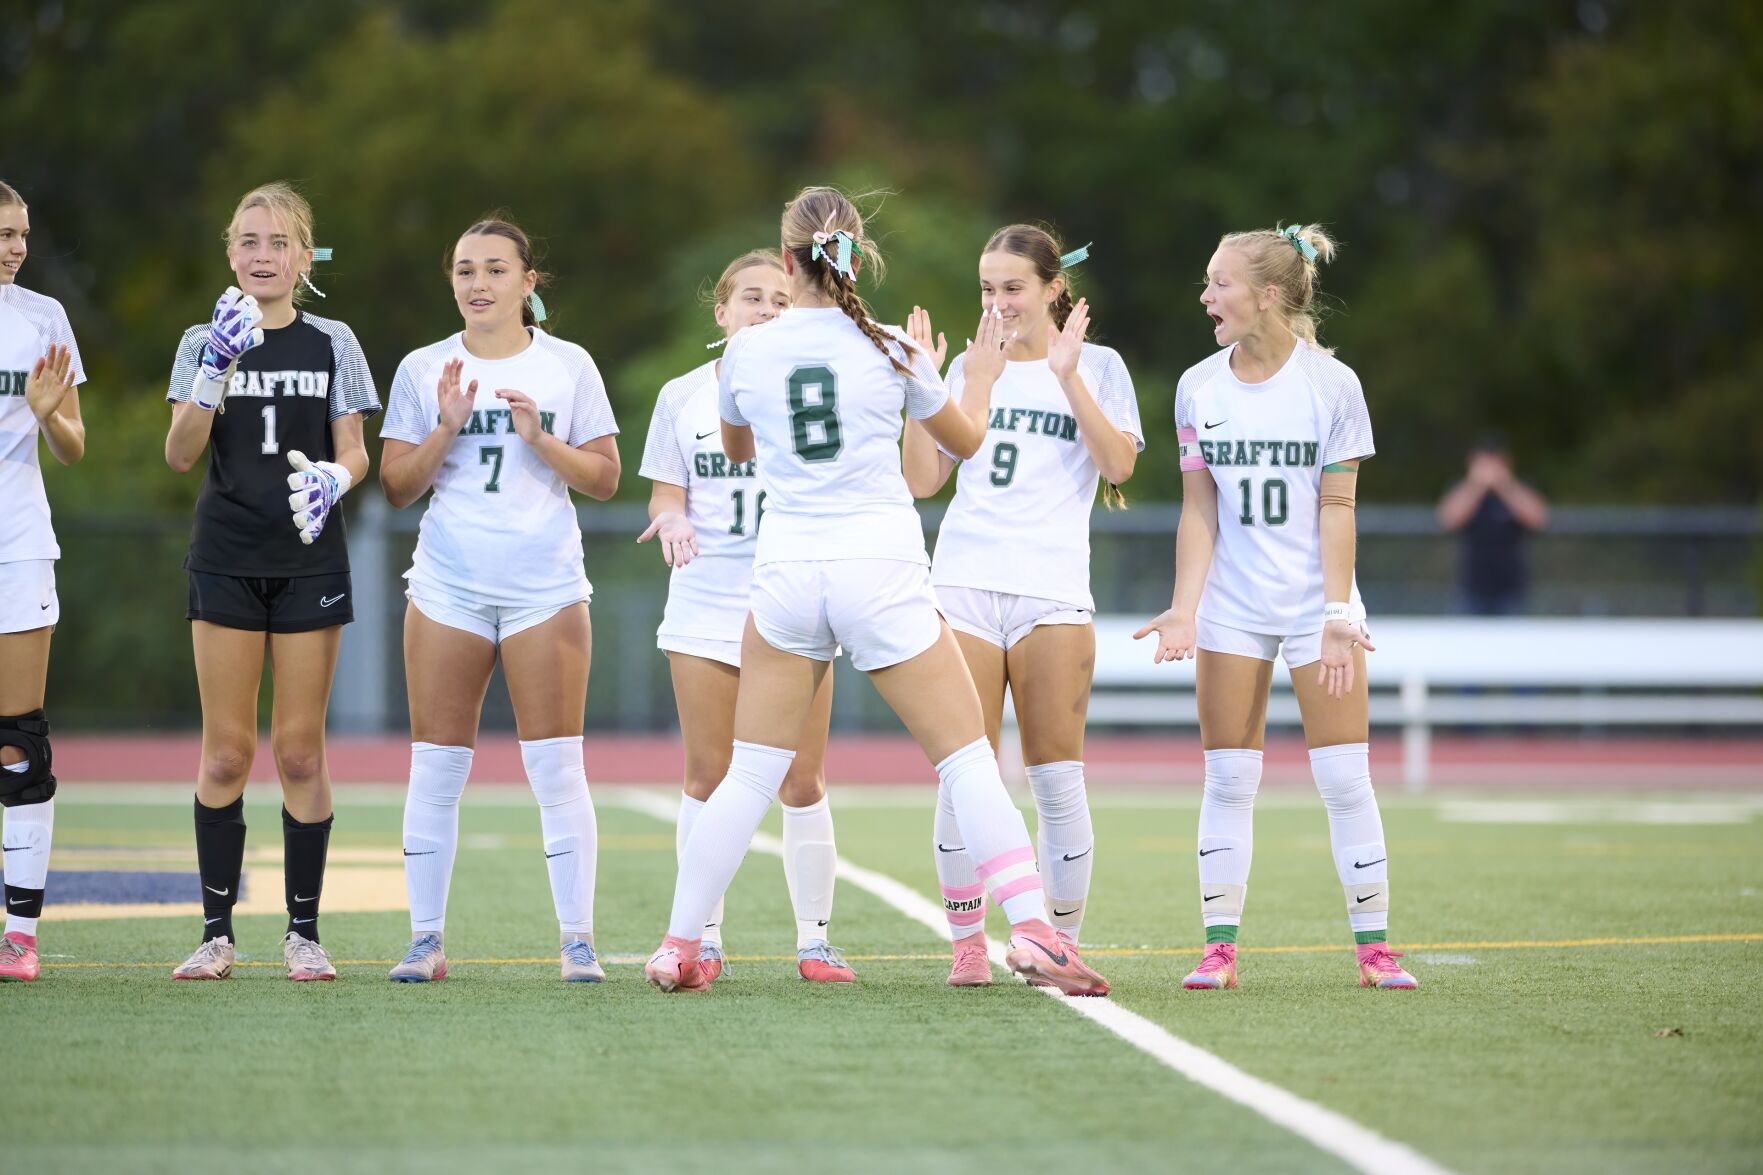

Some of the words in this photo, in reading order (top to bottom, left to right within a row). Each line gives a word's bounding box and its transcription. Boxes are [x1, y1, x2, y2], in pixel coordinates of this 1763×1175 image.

[229, 370, 329, 398] RAFTON
[262, 405, 279, 454] 1
[785, 363, 843, 464] 8
[987, 407, 1078, 443] AFTON
[479, 445, 504, 493] 7
[989, 441, 1020, 488] 9
[1199, 440, 1319, 467] GRAFTON
[1238, 478, 1289, 527] 10
[944, 896, 982, 912] CAPTAIN
